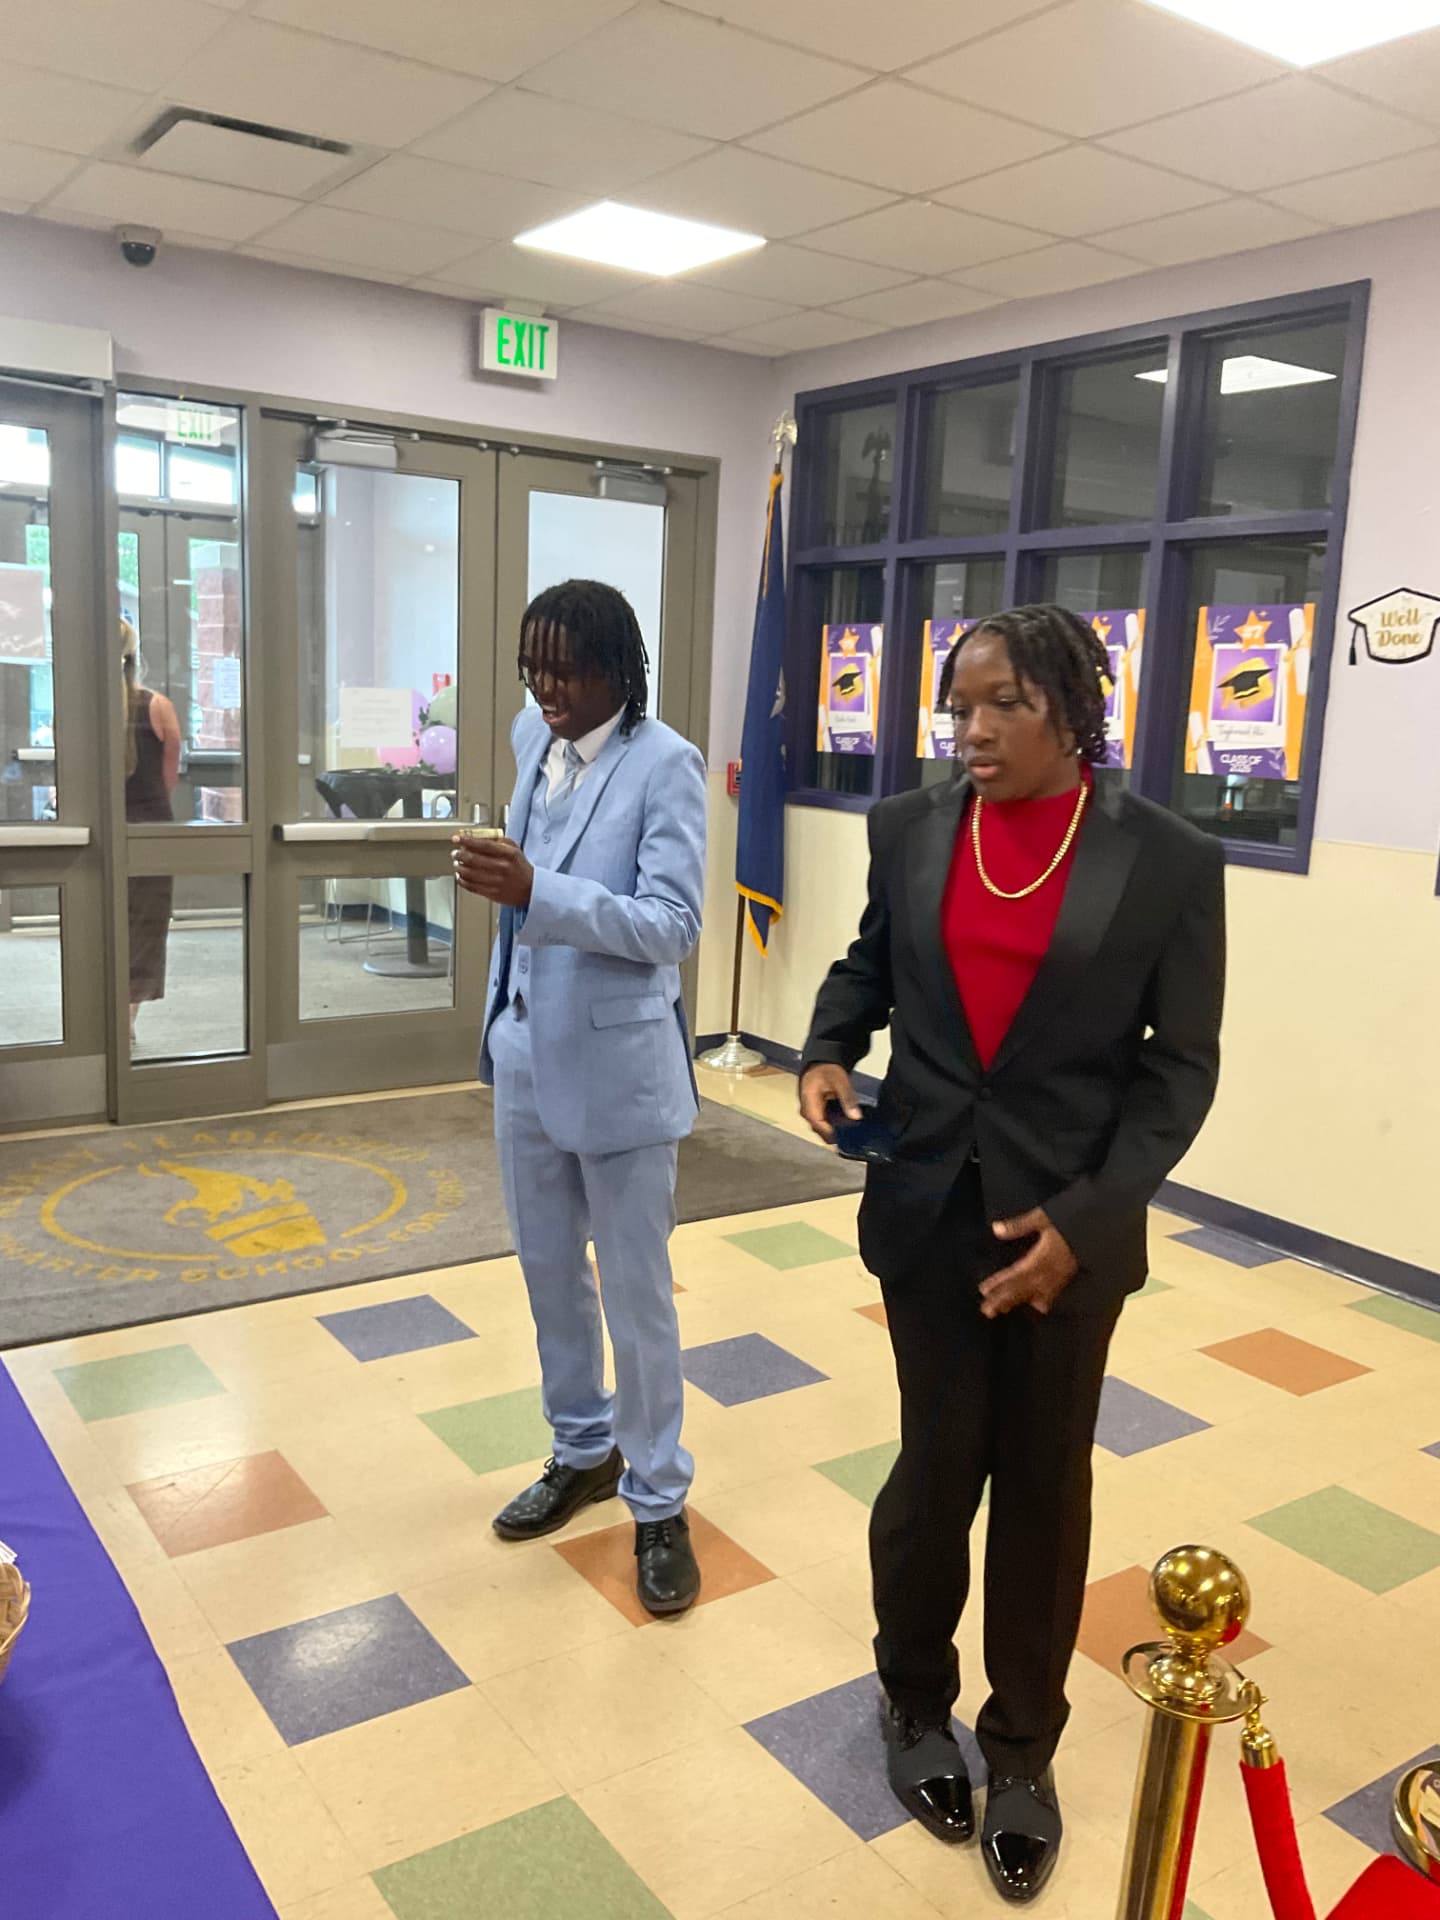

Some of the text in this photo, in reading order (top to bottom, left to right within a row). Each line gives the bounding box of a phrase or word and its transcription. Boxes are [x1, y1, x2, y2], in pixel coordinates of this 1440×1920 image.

[497, 317, 550, 371] EXIT
[177, 407, 214, 440] EXIT
[1380, 608, 1421, 627] Well
[1376, 629, 1423, 648] Done
[1220, 753, 1249, 765] CLASS
[179, 1242, 390, 1283] SCHOOL
[386, 1211, 449, 1243] FOR
